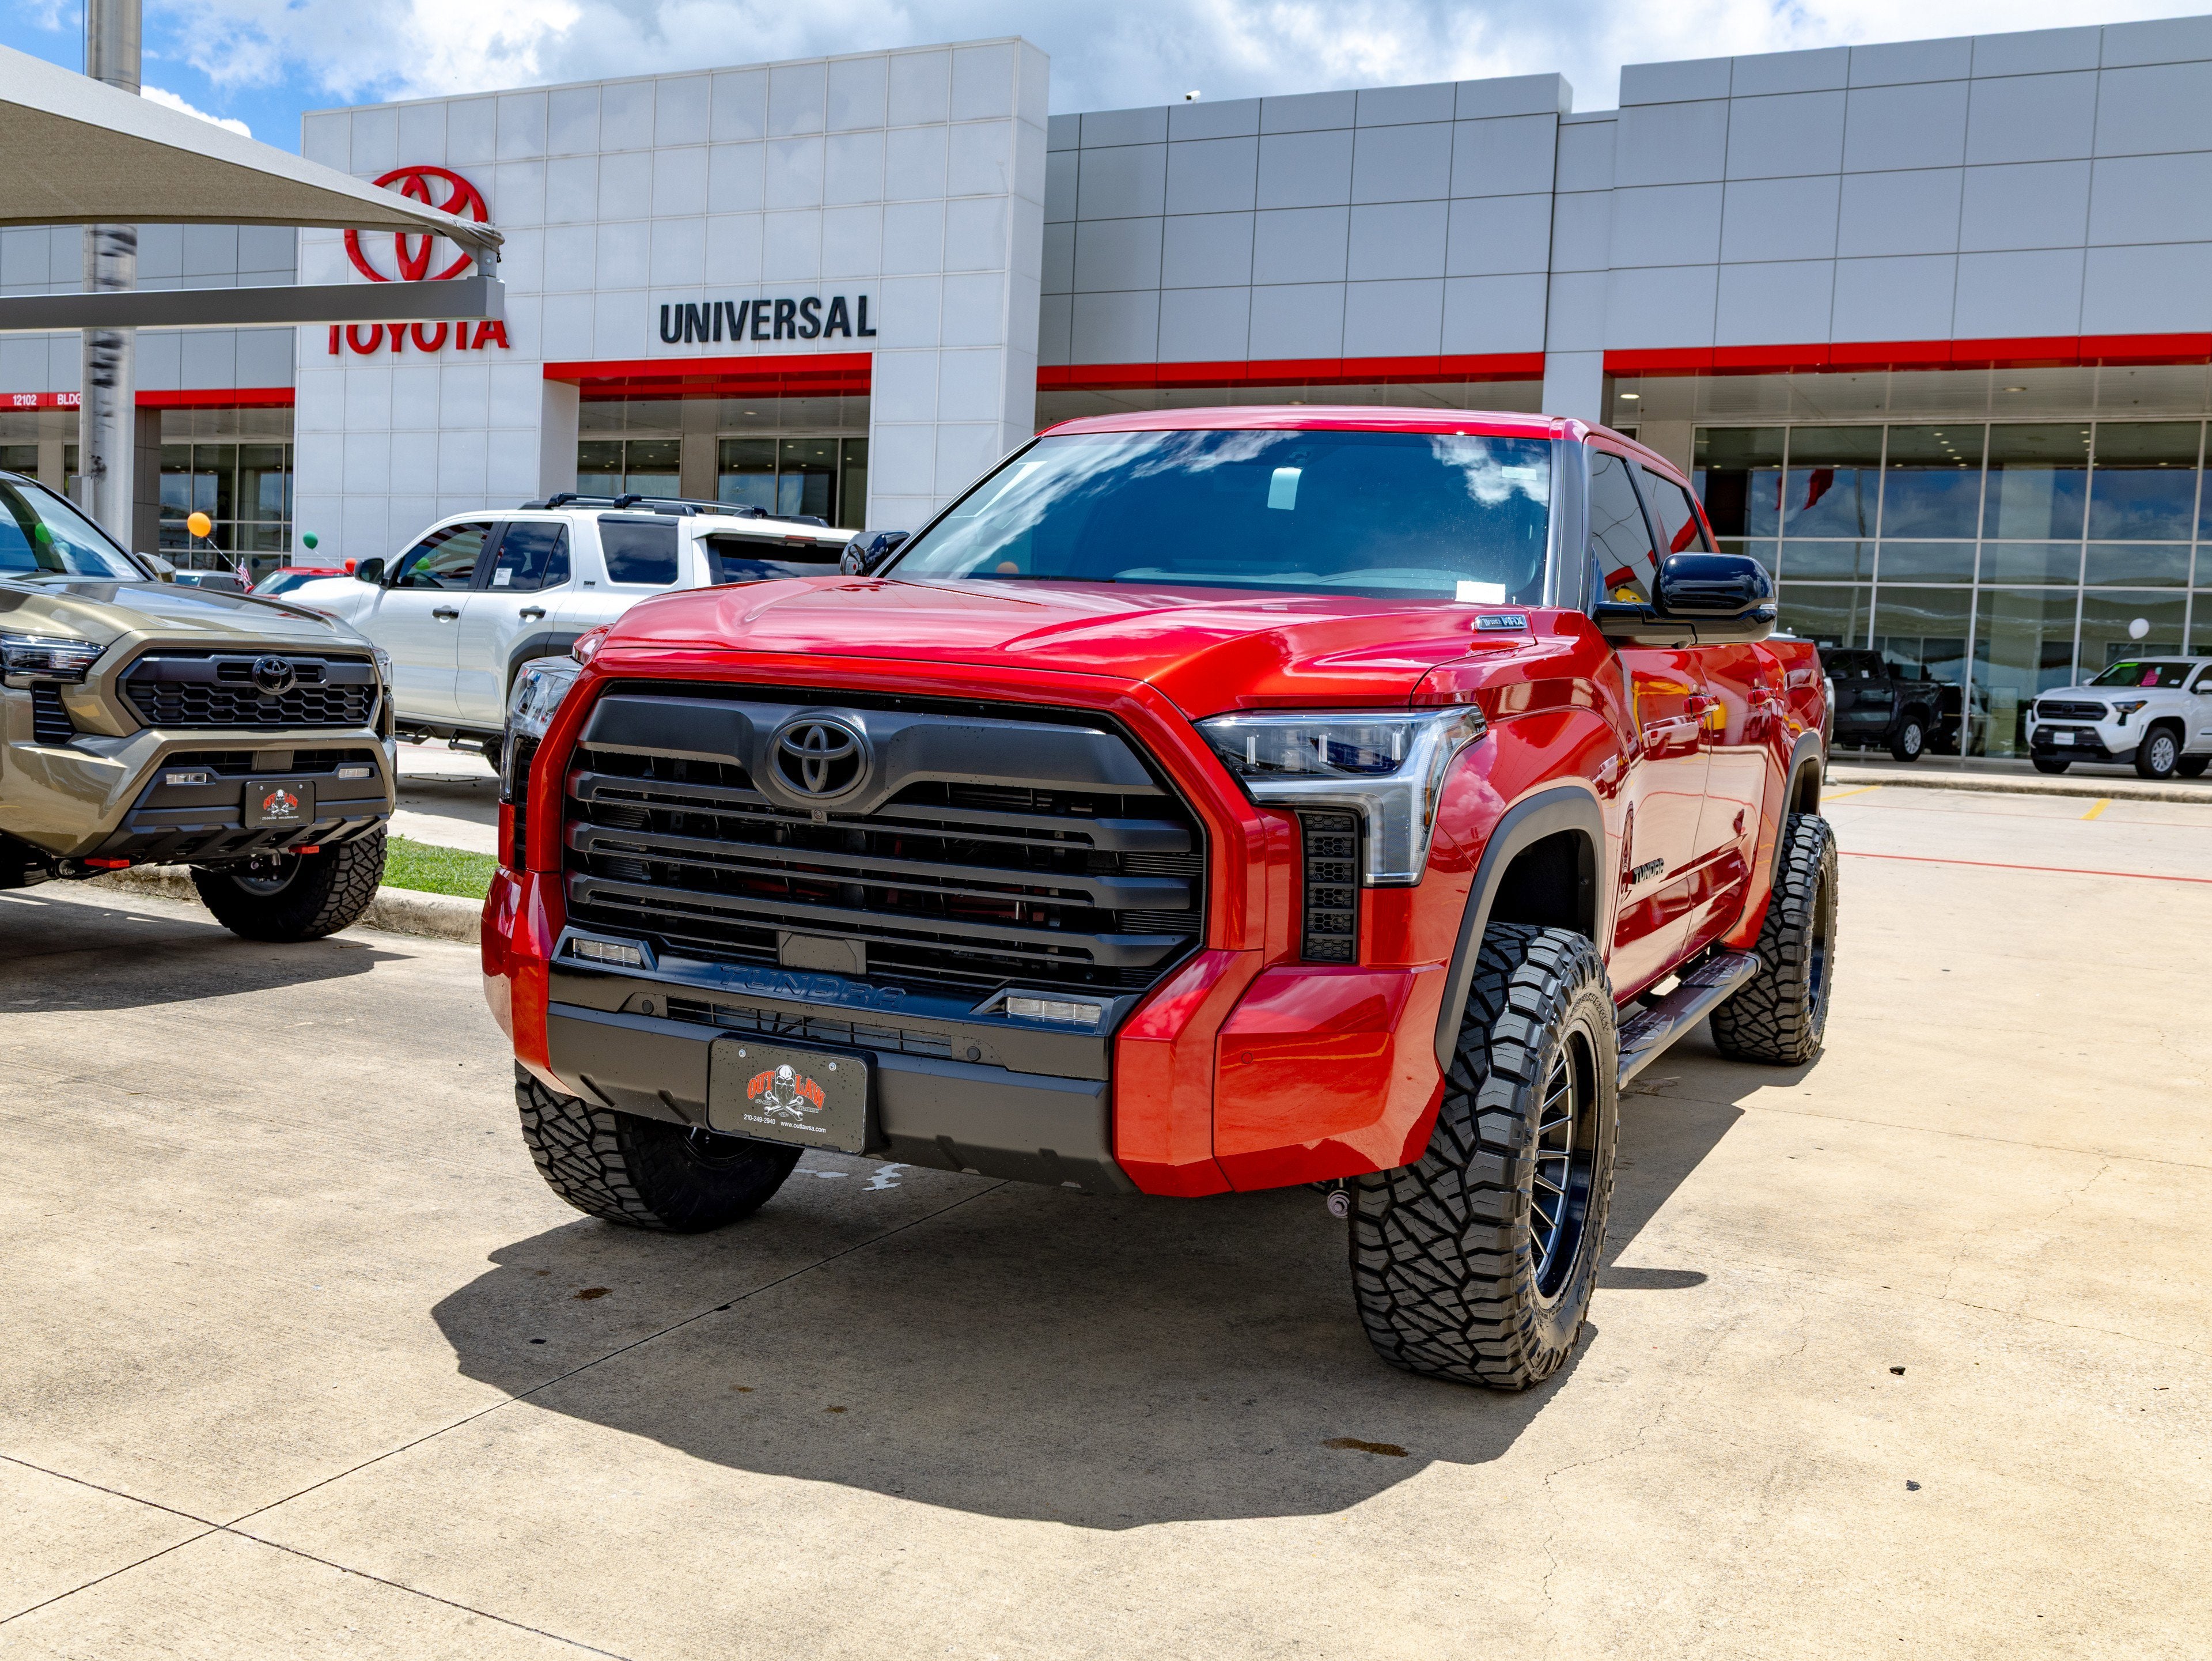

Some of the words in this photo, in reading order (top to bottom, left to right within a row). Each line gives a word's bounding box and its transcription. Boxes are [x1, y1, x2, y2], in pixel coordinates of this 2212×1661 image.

[660, 295, 877, 344] UNIVERSAL
[13, 394, 37, 406] 12102
[1632, 858, 1664, 884] TUNDRA
[720, 965, 907, 1008] TUNDRA
[744, 1114, 776, 1125] 210-249-2940
[780, 1121, 827, 1133] www.outlawsa.com
